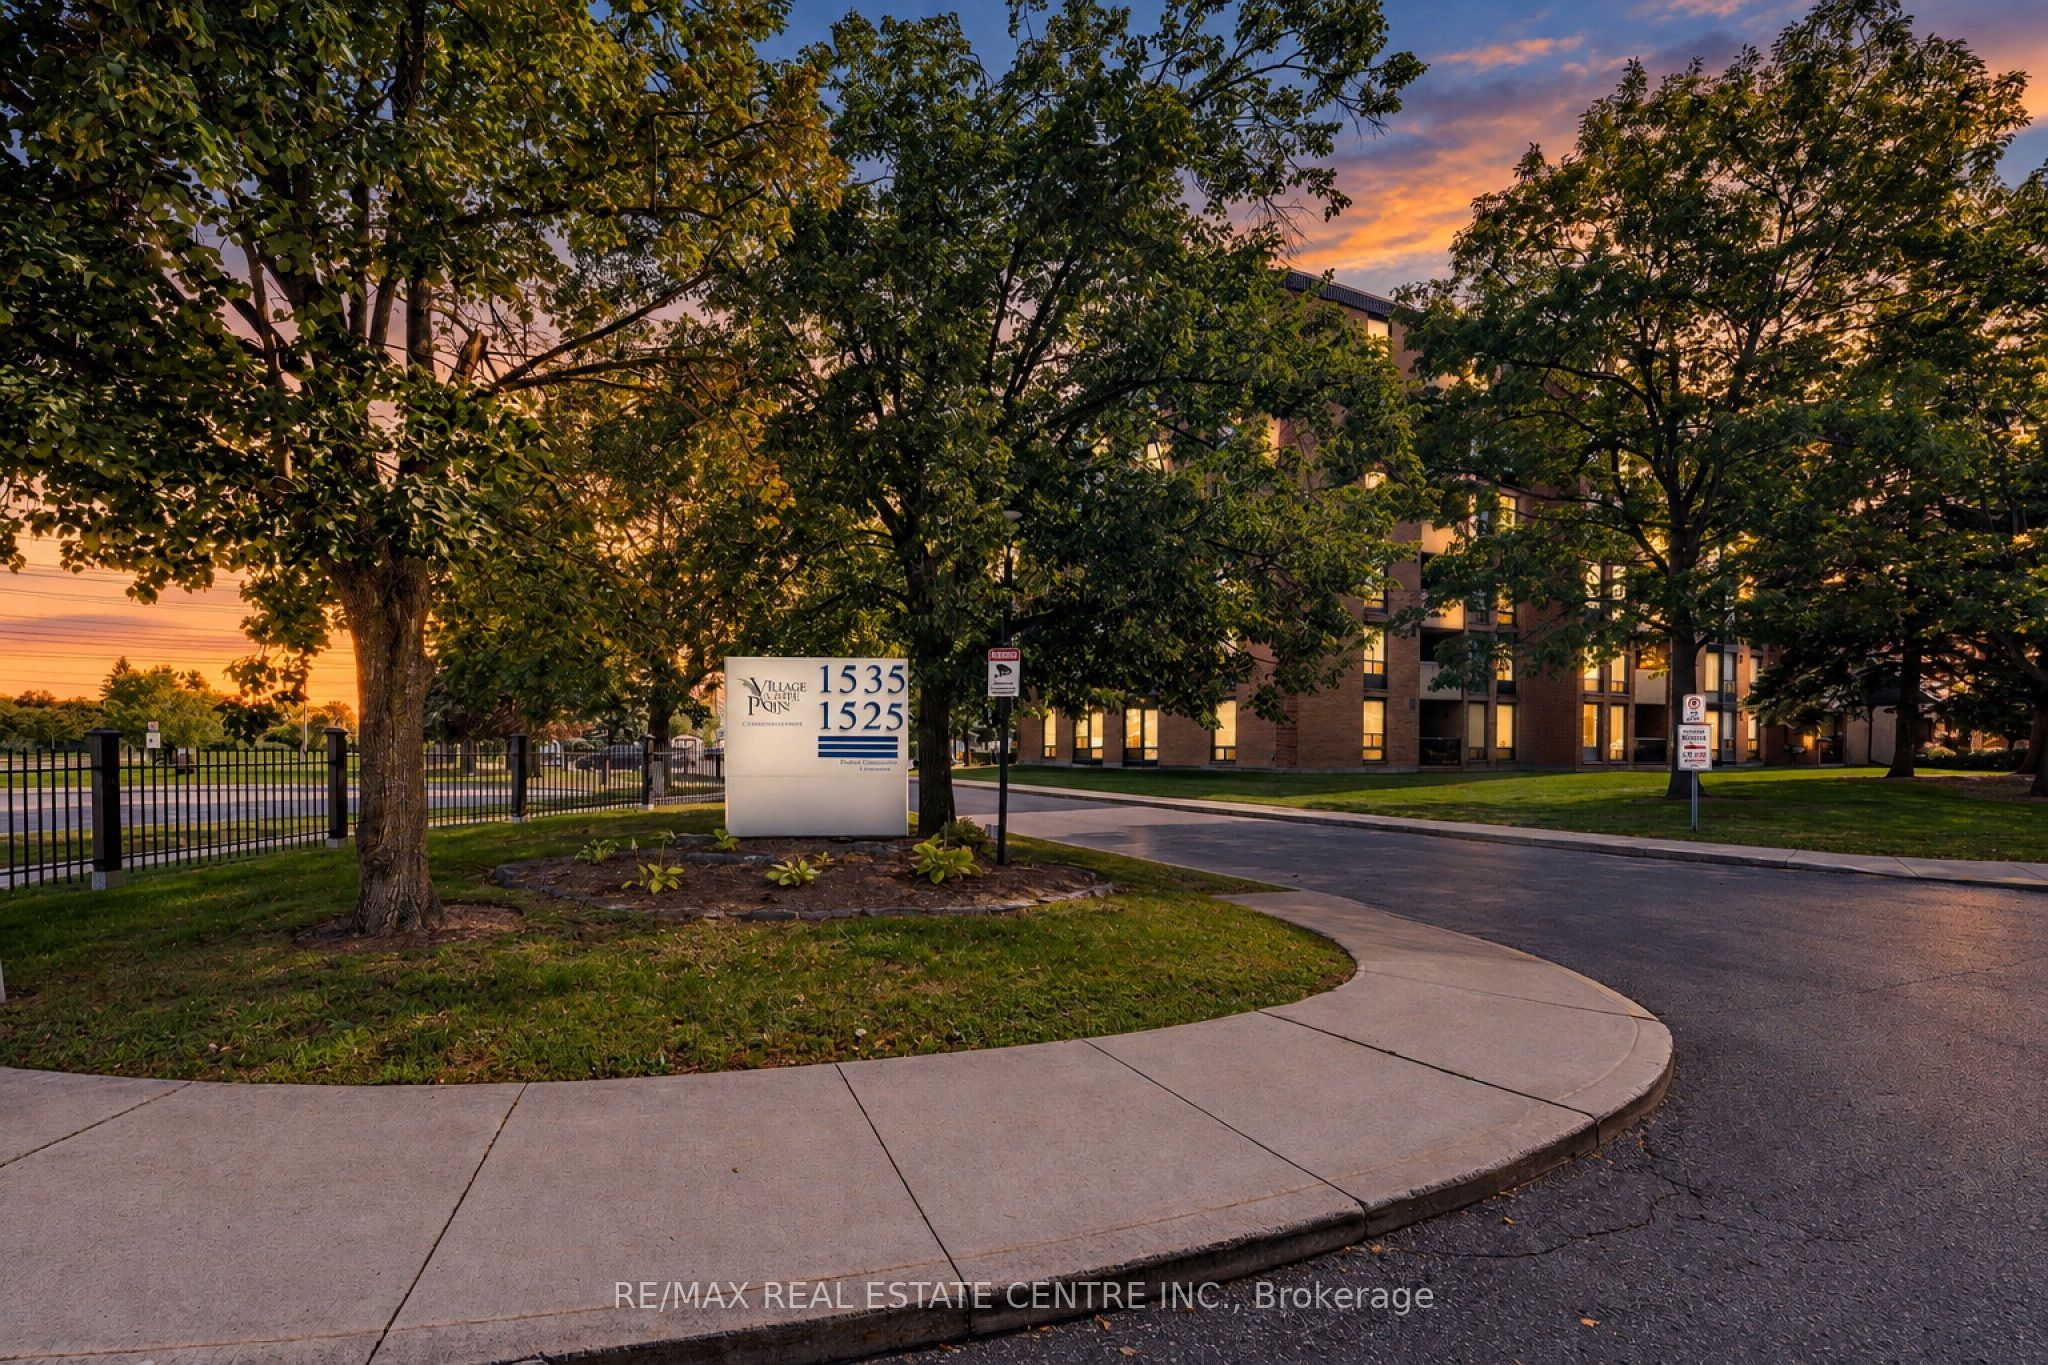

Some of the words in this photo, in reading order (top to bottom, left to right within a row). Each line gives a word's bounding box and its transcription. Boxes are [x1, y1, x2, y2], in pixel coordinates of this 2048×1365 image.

[749, 677, 807, 696] VILLAGE
[820, 664, 905, 694] 1535
[820, 701, 904, 731] 1525
